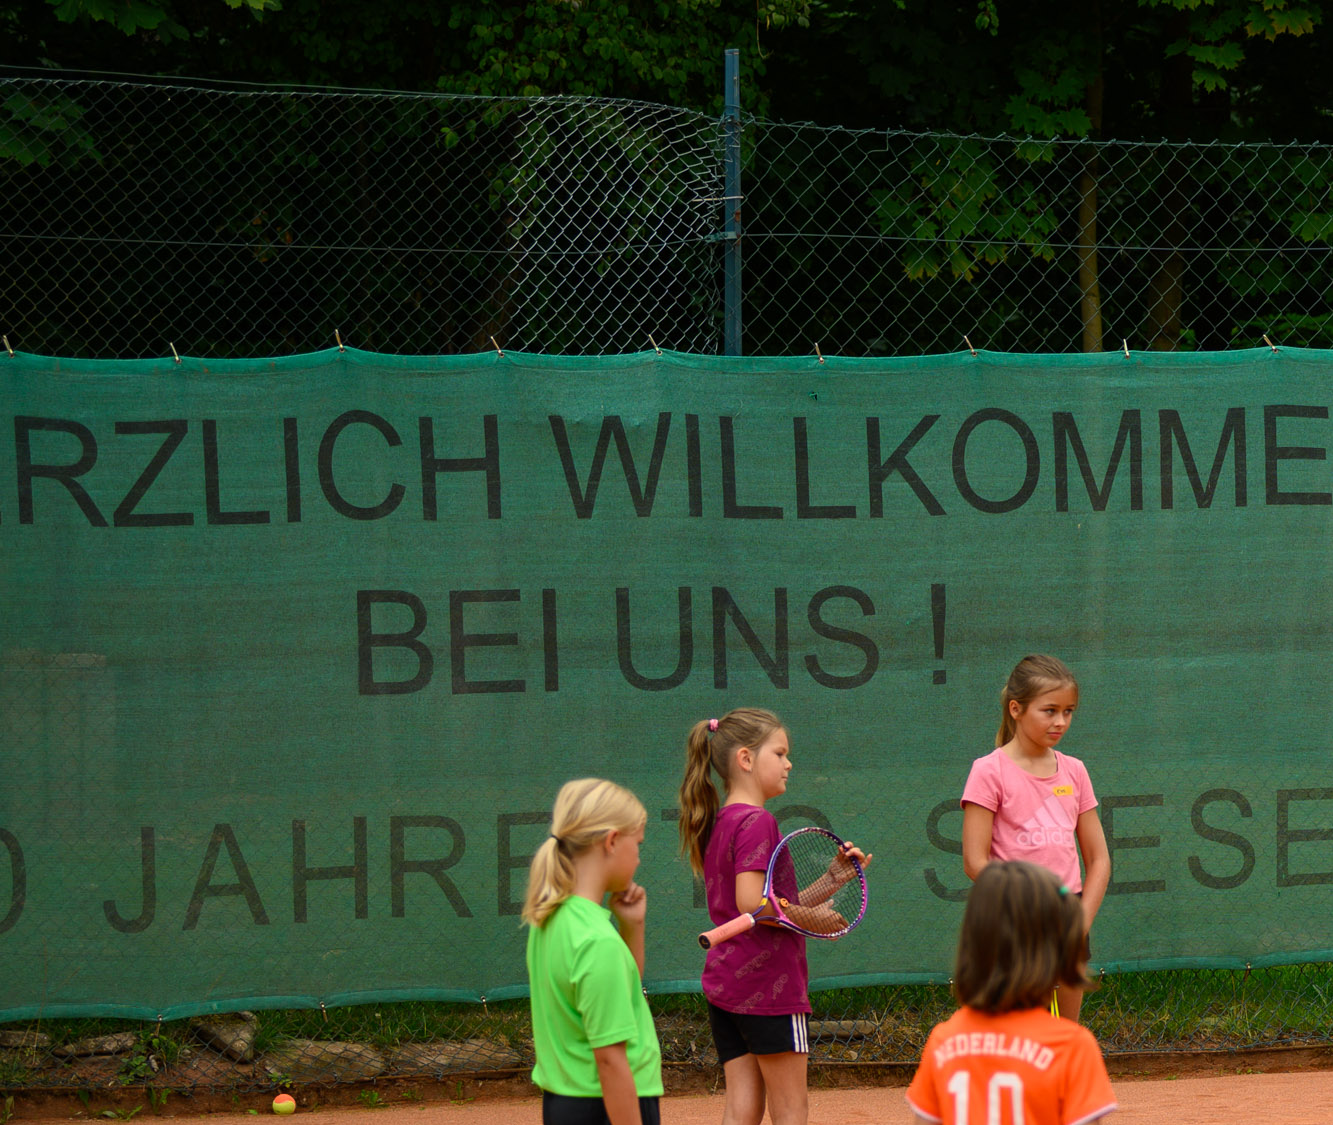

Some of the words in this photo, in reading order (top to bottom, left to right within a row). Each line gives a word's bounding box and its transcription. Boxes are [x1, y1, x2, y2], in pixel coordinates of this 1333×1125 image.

[13, 409, 502, 528] RZLICH
[356, 588, 559, 696] BEI
[615, 585, 881, 692] UNS
[933, 1032, 1055, 1071] NEDERLAND
